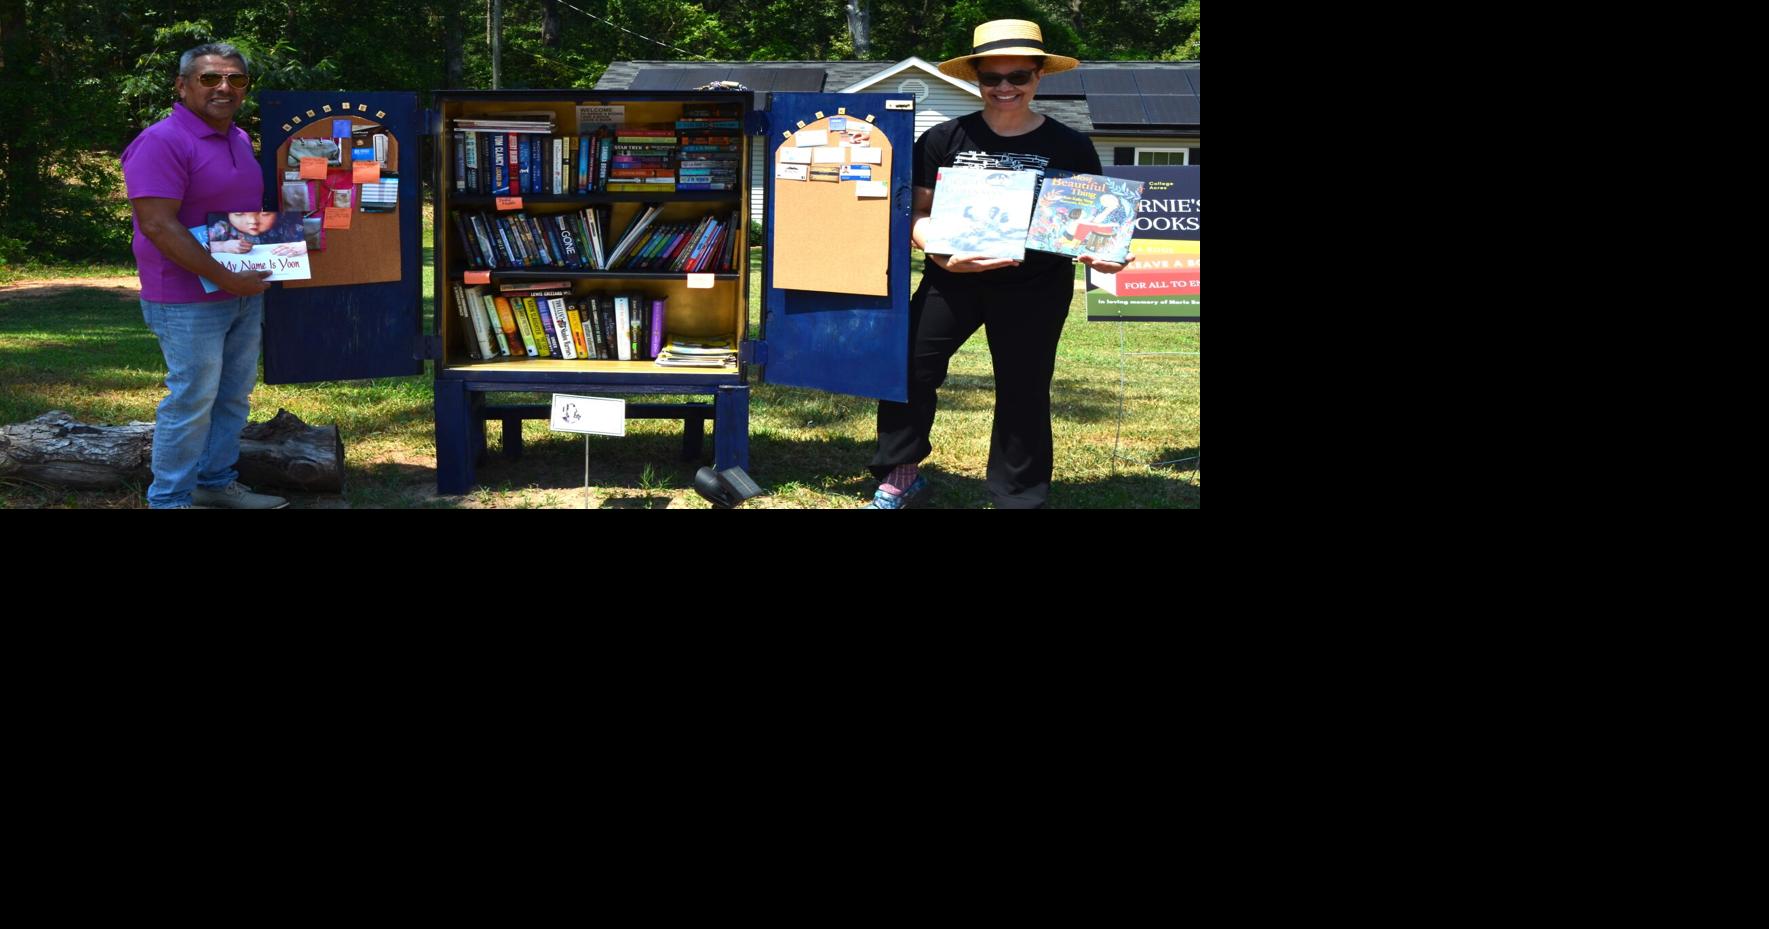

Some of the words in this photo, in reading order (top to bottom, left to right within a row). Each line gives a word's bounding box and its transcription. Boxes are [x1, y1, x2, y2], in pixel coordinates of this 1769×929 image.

[495, 136, 504, 146] TOM
[495, 146, 504, 166] CLANCY
[1053, 176, 1106, 192] Beautiful
[1072, 189, 1096, 200] Thing
[1136, 217, 1200, 230] OOKS
[562, 230, 576, 254] GONE
[221, 260, 237, 272] My
[240, 260, 267, 271] Name
[269, 259, 277, 270] Is
[278, 258, 300, 272] Yoon
[549, 336, 557, 349] UNDER
